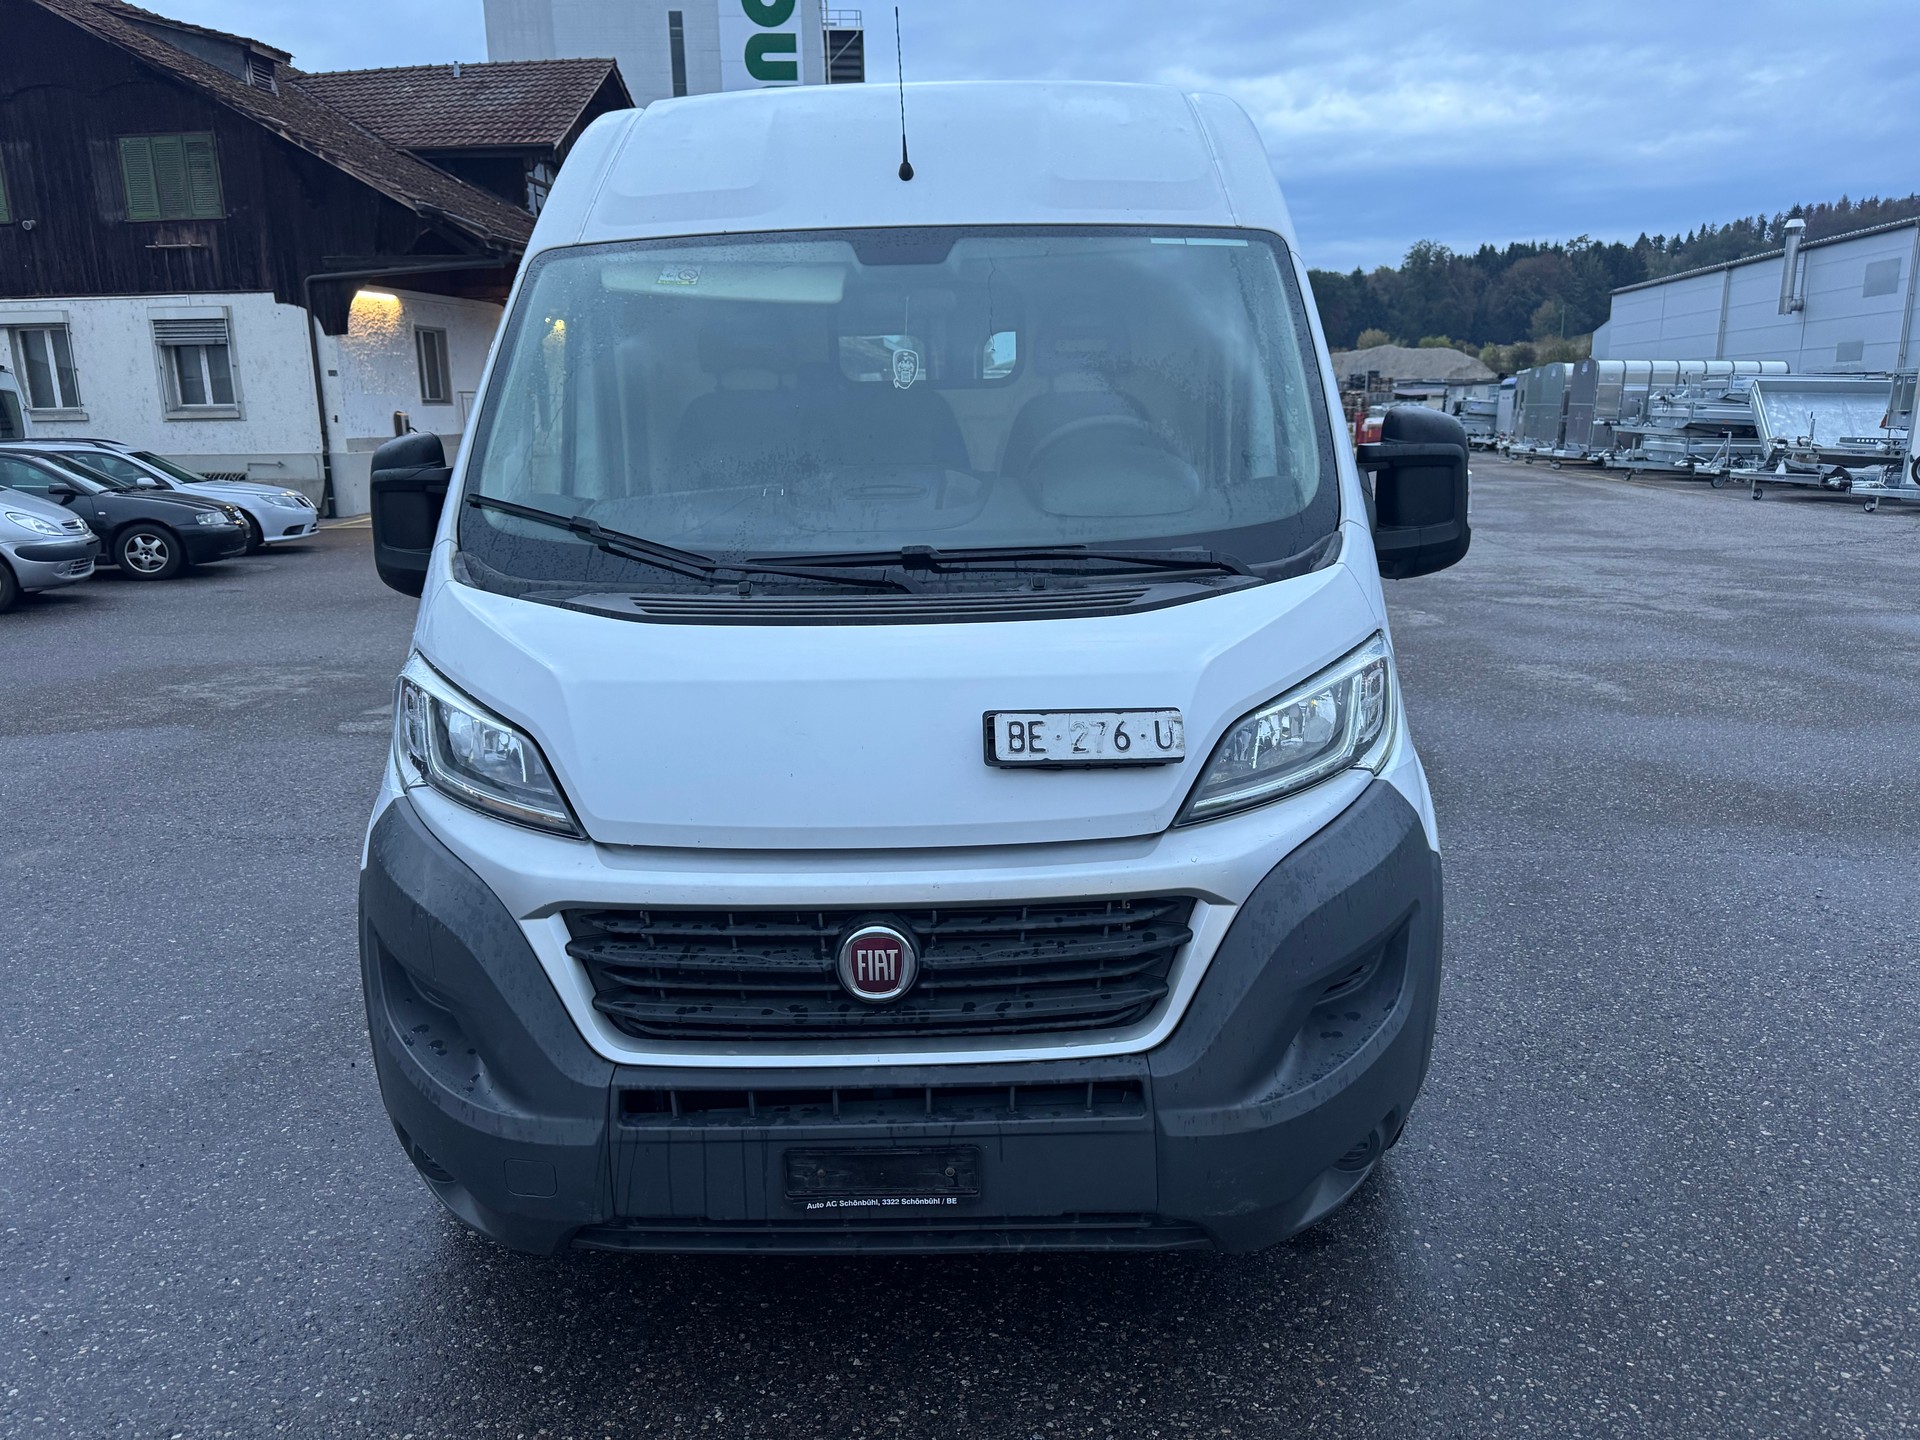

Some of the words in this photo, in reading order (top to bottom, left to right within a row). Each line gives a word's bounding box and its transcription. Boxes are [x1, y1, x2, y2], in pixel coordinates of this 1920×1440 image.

[857, 949, 898, 981] FIAT
[806, 1202, 825, 1210] Auto
[826, 1200, 838, 1208] AG
[839, 1198, 881, 1207] Schönbühl,
[881, 1198, 900, 1206] 3322
[901, 1197, 940, 1205] Schönbühl
[946, 1197, 957, 1205] BE
